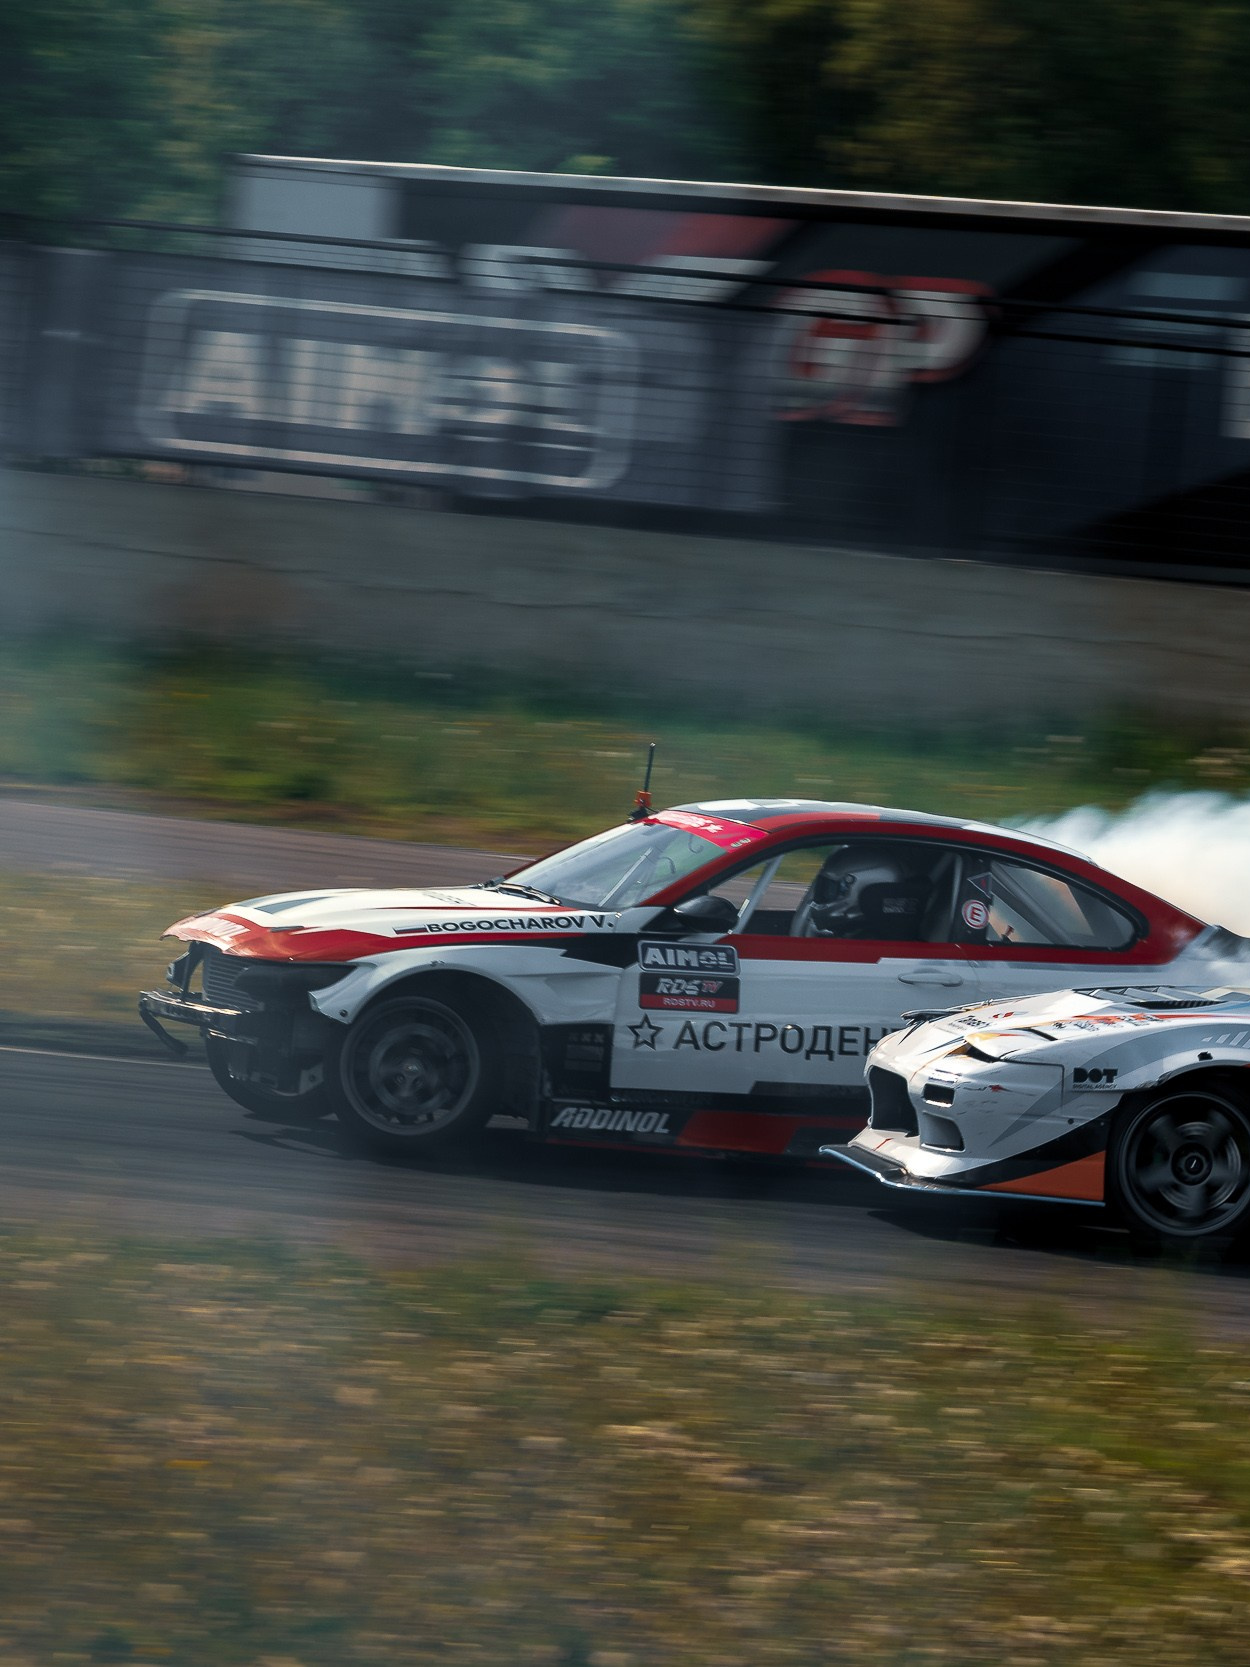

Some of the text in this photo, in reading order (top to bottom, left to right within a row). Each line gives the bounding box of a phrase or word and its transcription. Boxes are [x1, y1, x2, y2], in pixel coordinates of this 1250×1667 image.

[428, 914, 614, 933] BOGOCHAROV V.
[643, 947, 734, 969] AIMOL
[663, 997, 716, 1008] RDSTV.RU
[672, 1020, 906, 1062] АСТРОДЕН
[1073, 1067, 1118, 1083] DOT
[550, 1107, 670, 1134] ADDINOL
